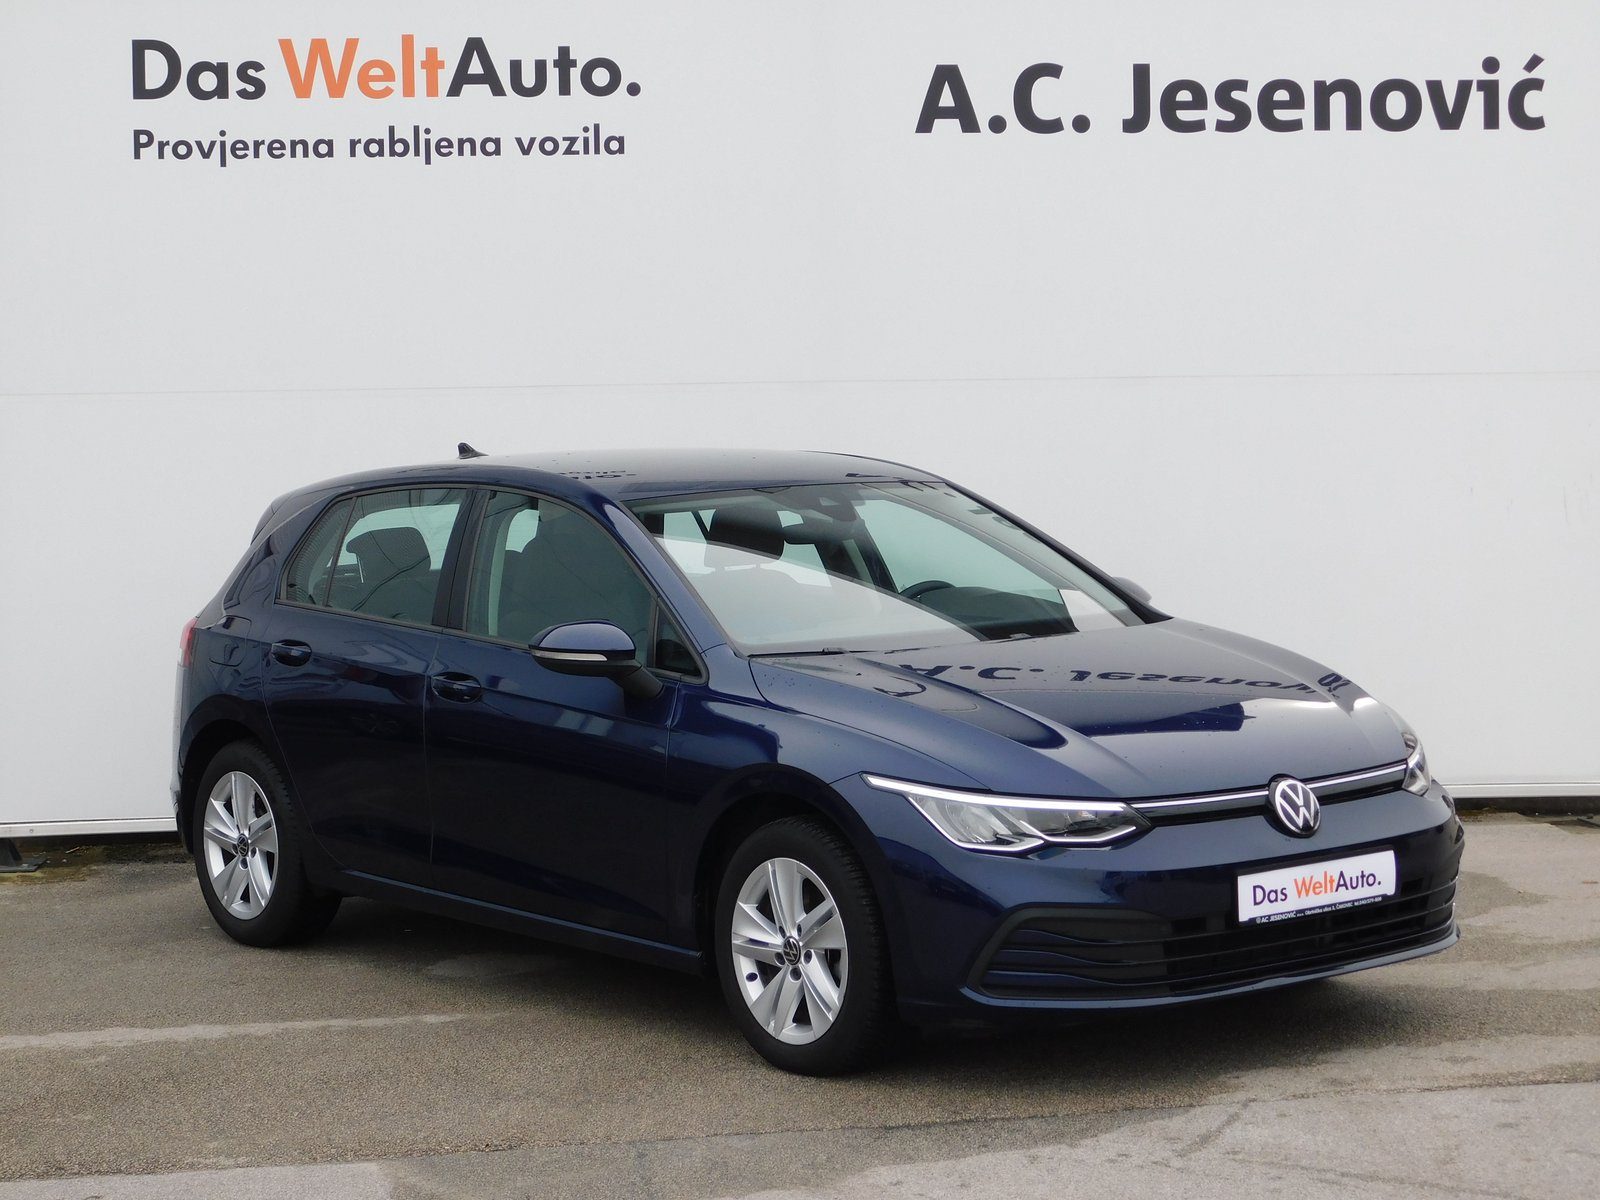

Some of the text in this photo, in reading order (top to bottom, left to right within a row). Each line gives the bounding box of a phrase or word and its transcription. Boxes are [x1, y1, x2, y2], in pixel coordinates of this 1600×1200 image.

[132, 34, 642, 101] Das WeltAuto.
[915, 53, 1546, 135] A.C. Jesenović
[132, 123, 625, 168] Provjerena rabljena vozila
[1252, 870, 1382, 907] Das WeltAuto.
